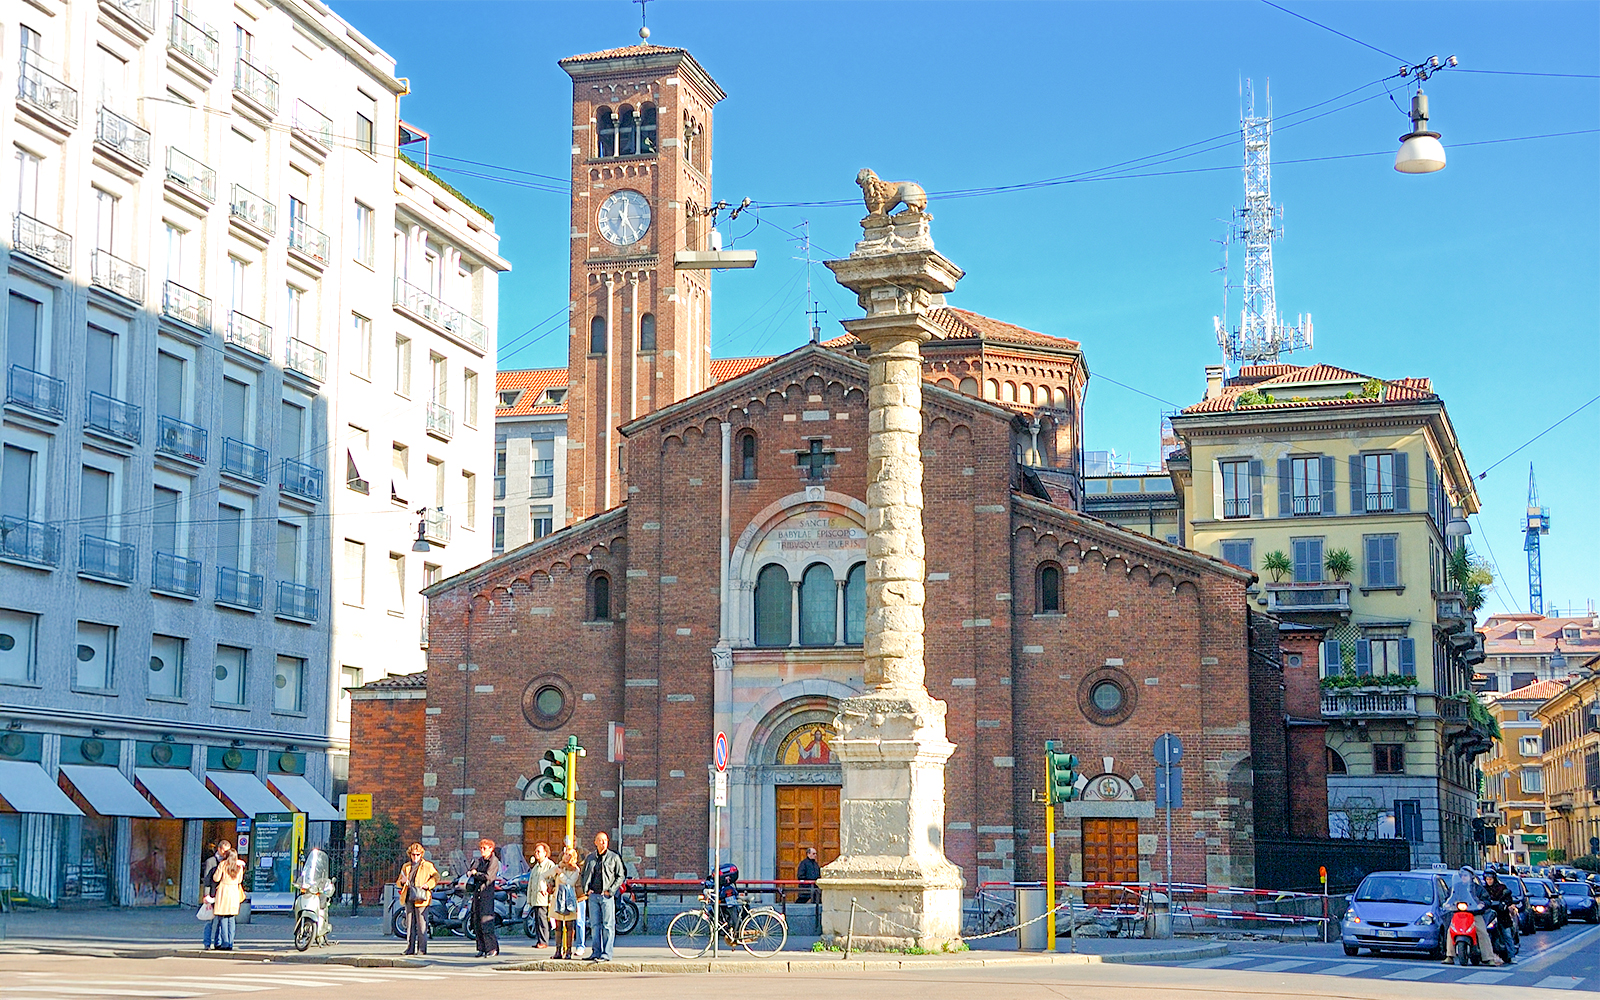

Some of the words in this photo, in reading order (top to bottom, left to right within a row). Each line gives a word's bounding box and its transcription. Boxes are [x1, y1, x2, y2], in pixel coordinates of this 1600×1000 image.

[799, 519, 836, 528] SANCTIS
[778, 530, 812, 539] BABYLAE
[816, 529, 857, 538] EPISCOPO
[615, 732, 623, 755] M
